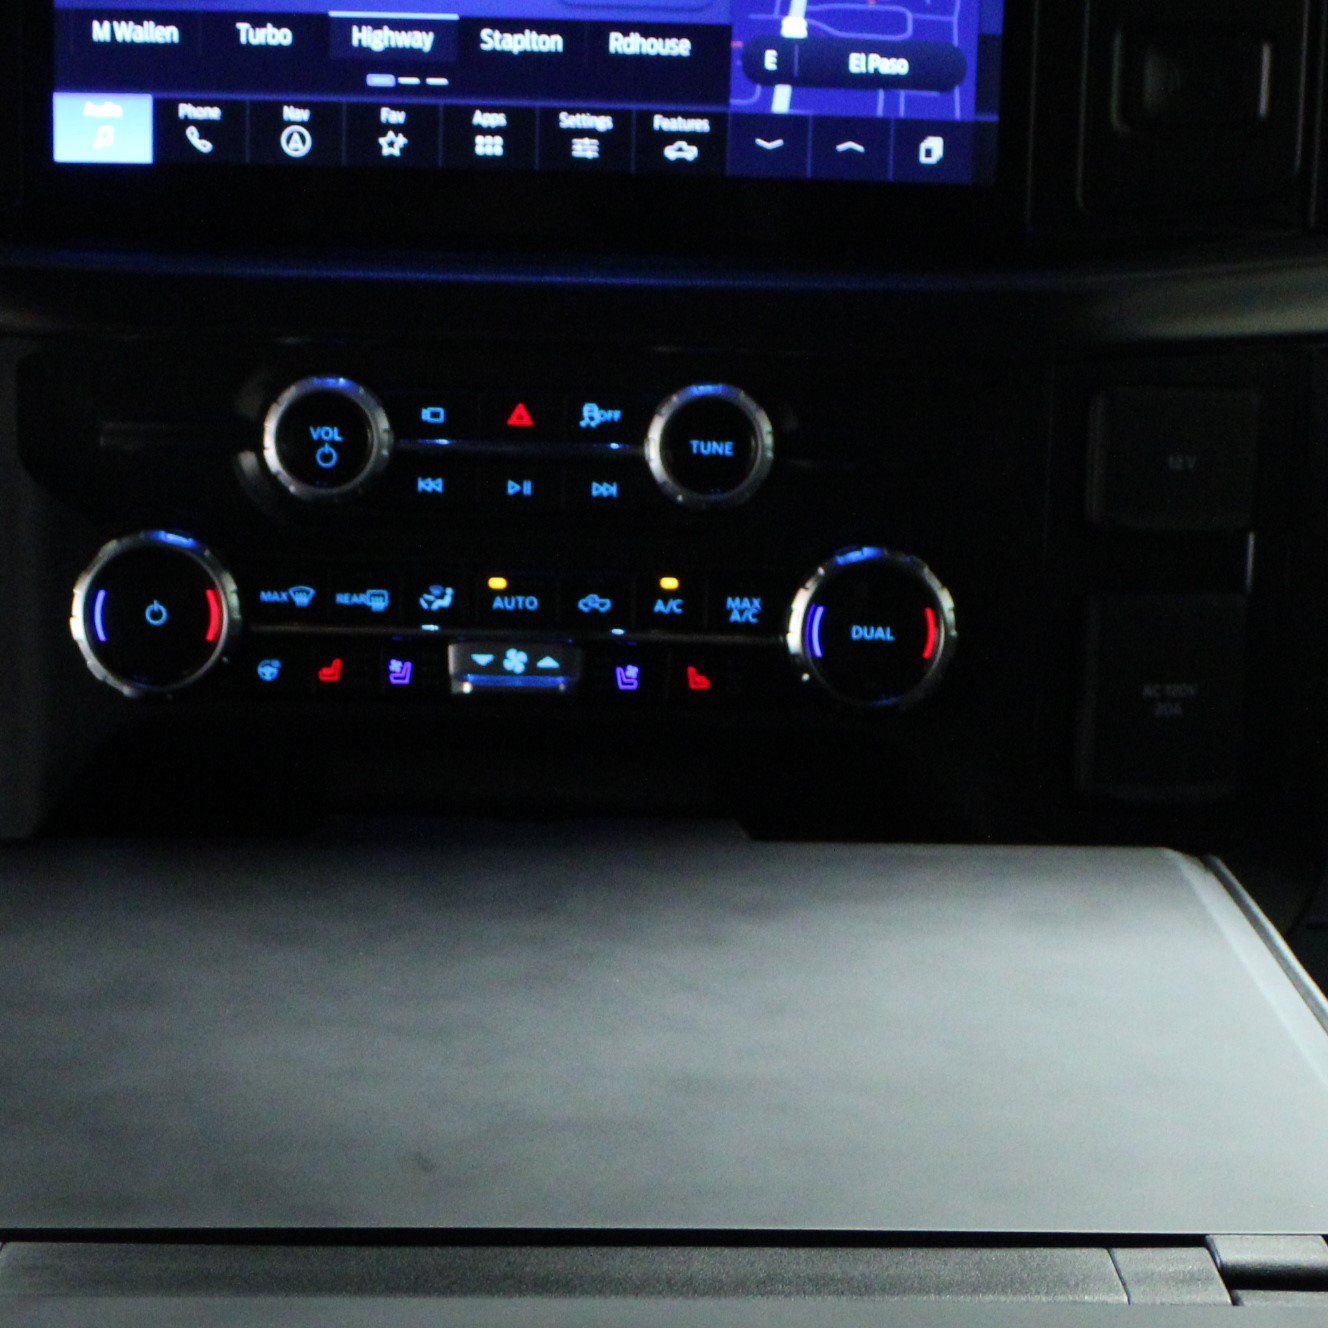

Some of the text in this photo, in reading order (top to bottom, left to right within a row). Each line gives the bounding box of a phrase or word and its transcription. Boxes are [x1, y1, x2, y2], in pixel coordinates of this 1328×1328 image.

[92, 20, 179, 43] M Wallen
[236, 22, 293, 46] Turbo
[352, 26, 434, 52] Highway
[480, 29, 563, 55] Staplton
[609, 32, 691, 56] Rdhouse
[765, 49, 777, 70] E
[849, 53, 909, 75] El Paso
[179, 103, 221, 120] Phone
[283, 106, 310, 122] Nav
[381, 107, 406, 124] Fav
[473, 110, 507, 128] Apps
[559, 112, 613, 132] Settings
[653, 115, 710, 132] Features
[598, 409, 621, 424] OFF
[310, 426, 343, 442] VOL
[690, 439, 734, 456] TUNE
[260, 592, 288, 602] MAX
[336, 593, 366, 605] REAR
[493, 596, 539, 610] AUTO
[727, 598, 761, 611] MAX
[653, 599, 683, 614] A/C
[730, 611, 759, 623] A/C
[850, 625, 895, 642] DUAL
